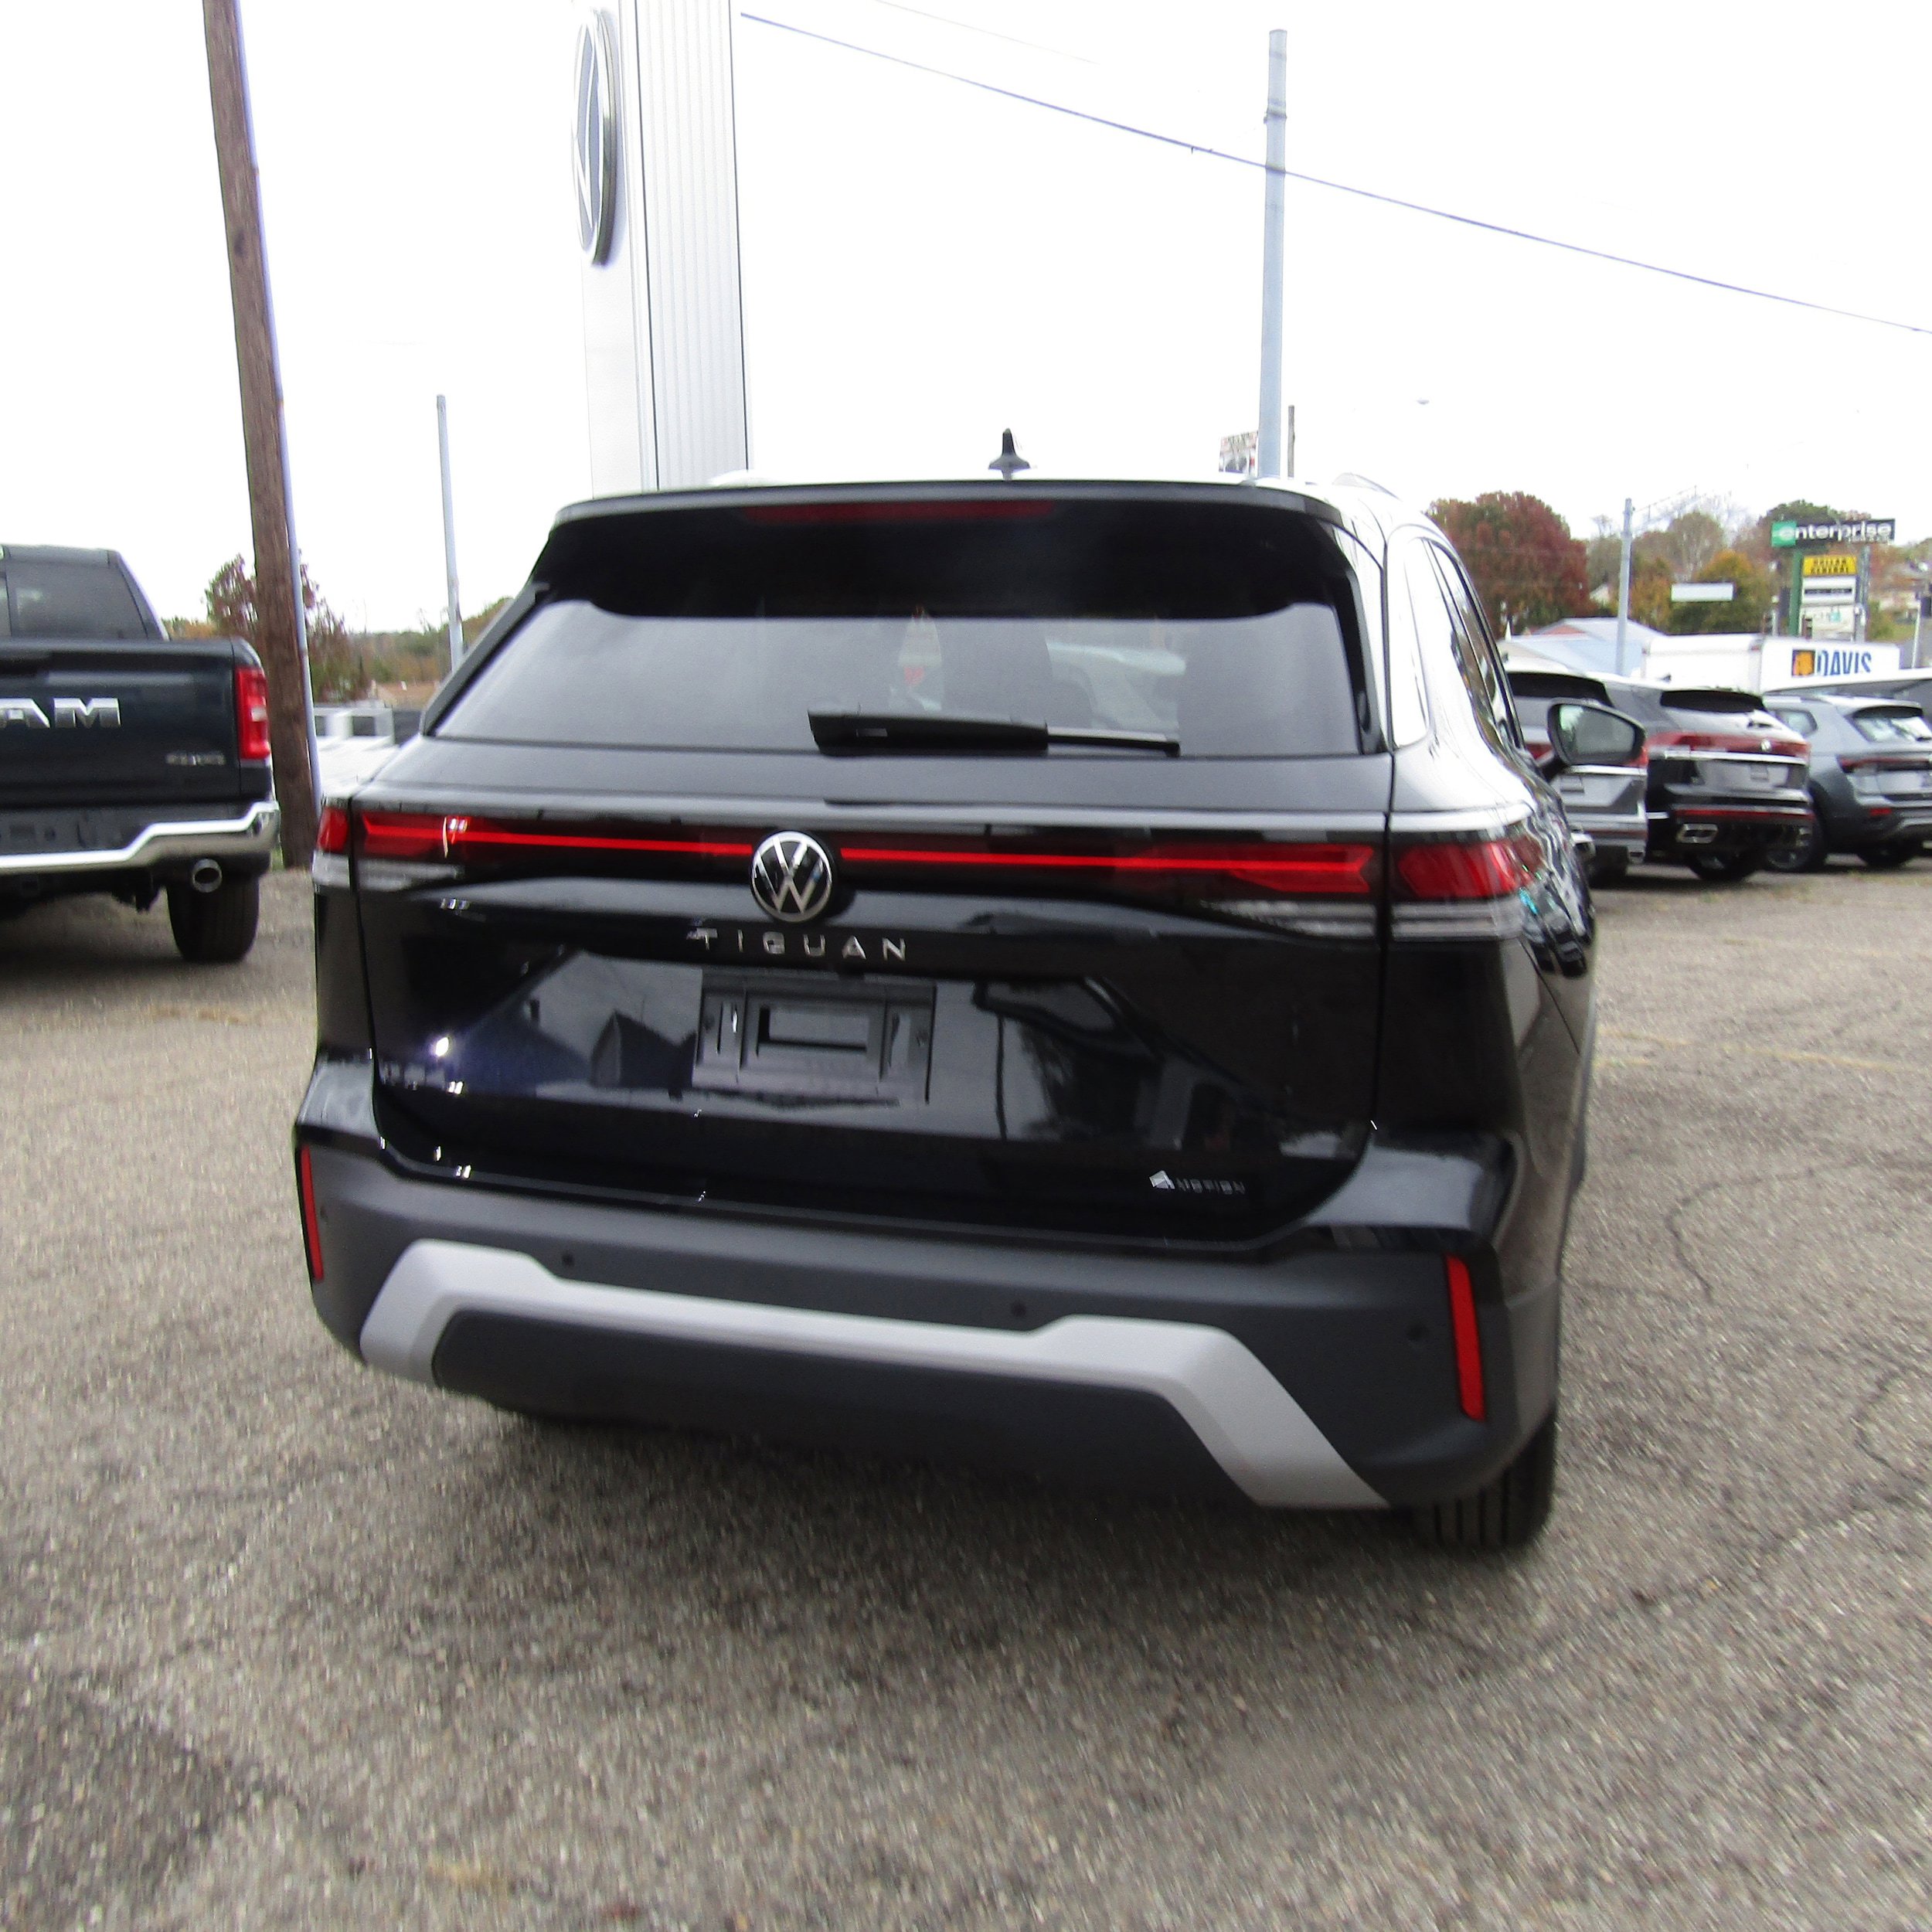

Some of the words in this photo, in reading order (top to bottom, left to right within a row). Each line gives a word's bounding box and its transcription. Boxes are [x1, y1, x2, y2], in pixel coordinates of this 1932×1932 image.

[1779, 522, 1892, 542] enterprise
[1816, 648, 1872, 677] DAVIS
[690, 927, 907, 961] TIGUAN
